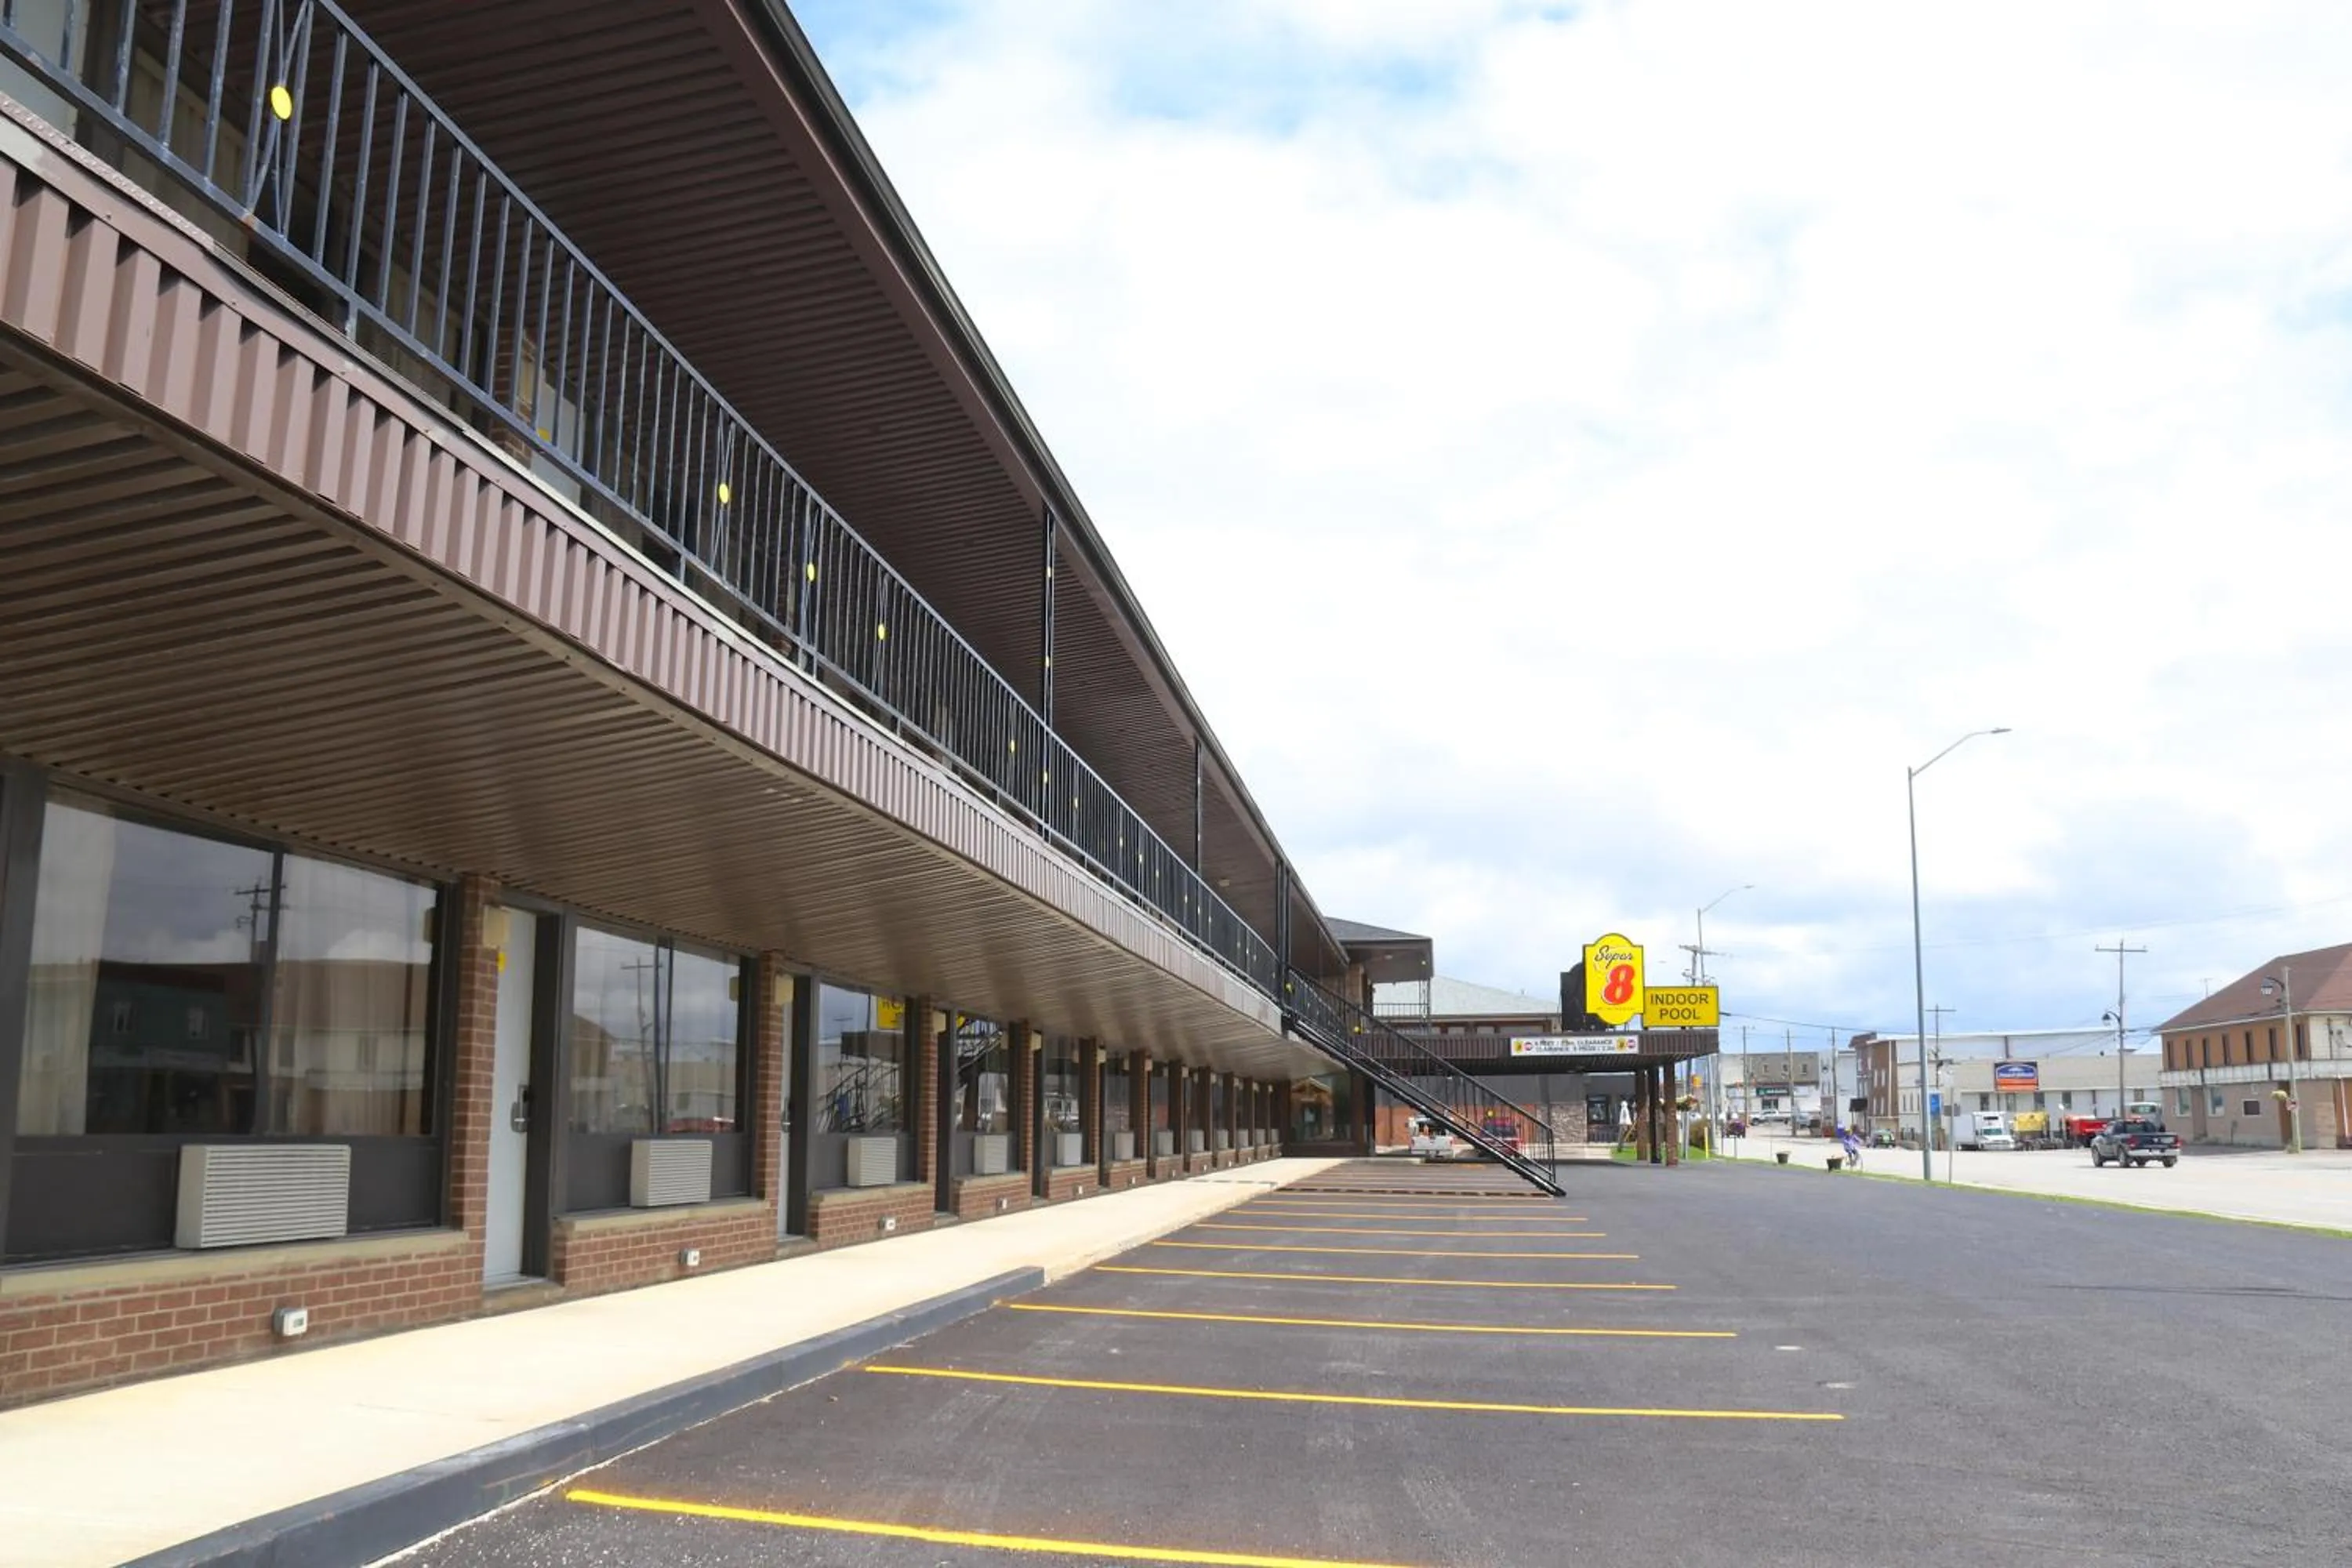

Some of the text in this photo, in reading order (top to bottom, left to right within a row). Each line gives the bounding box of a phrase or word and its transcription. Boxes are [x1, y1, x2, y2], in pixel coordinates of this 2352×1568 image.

[1594, 944, 1634, 970] Super
[1601, 964, 1635, 1005] 8
[1650, 993, 1709, 1005] INDOOR
[1659, 1007, 1700, 1020] POOL
